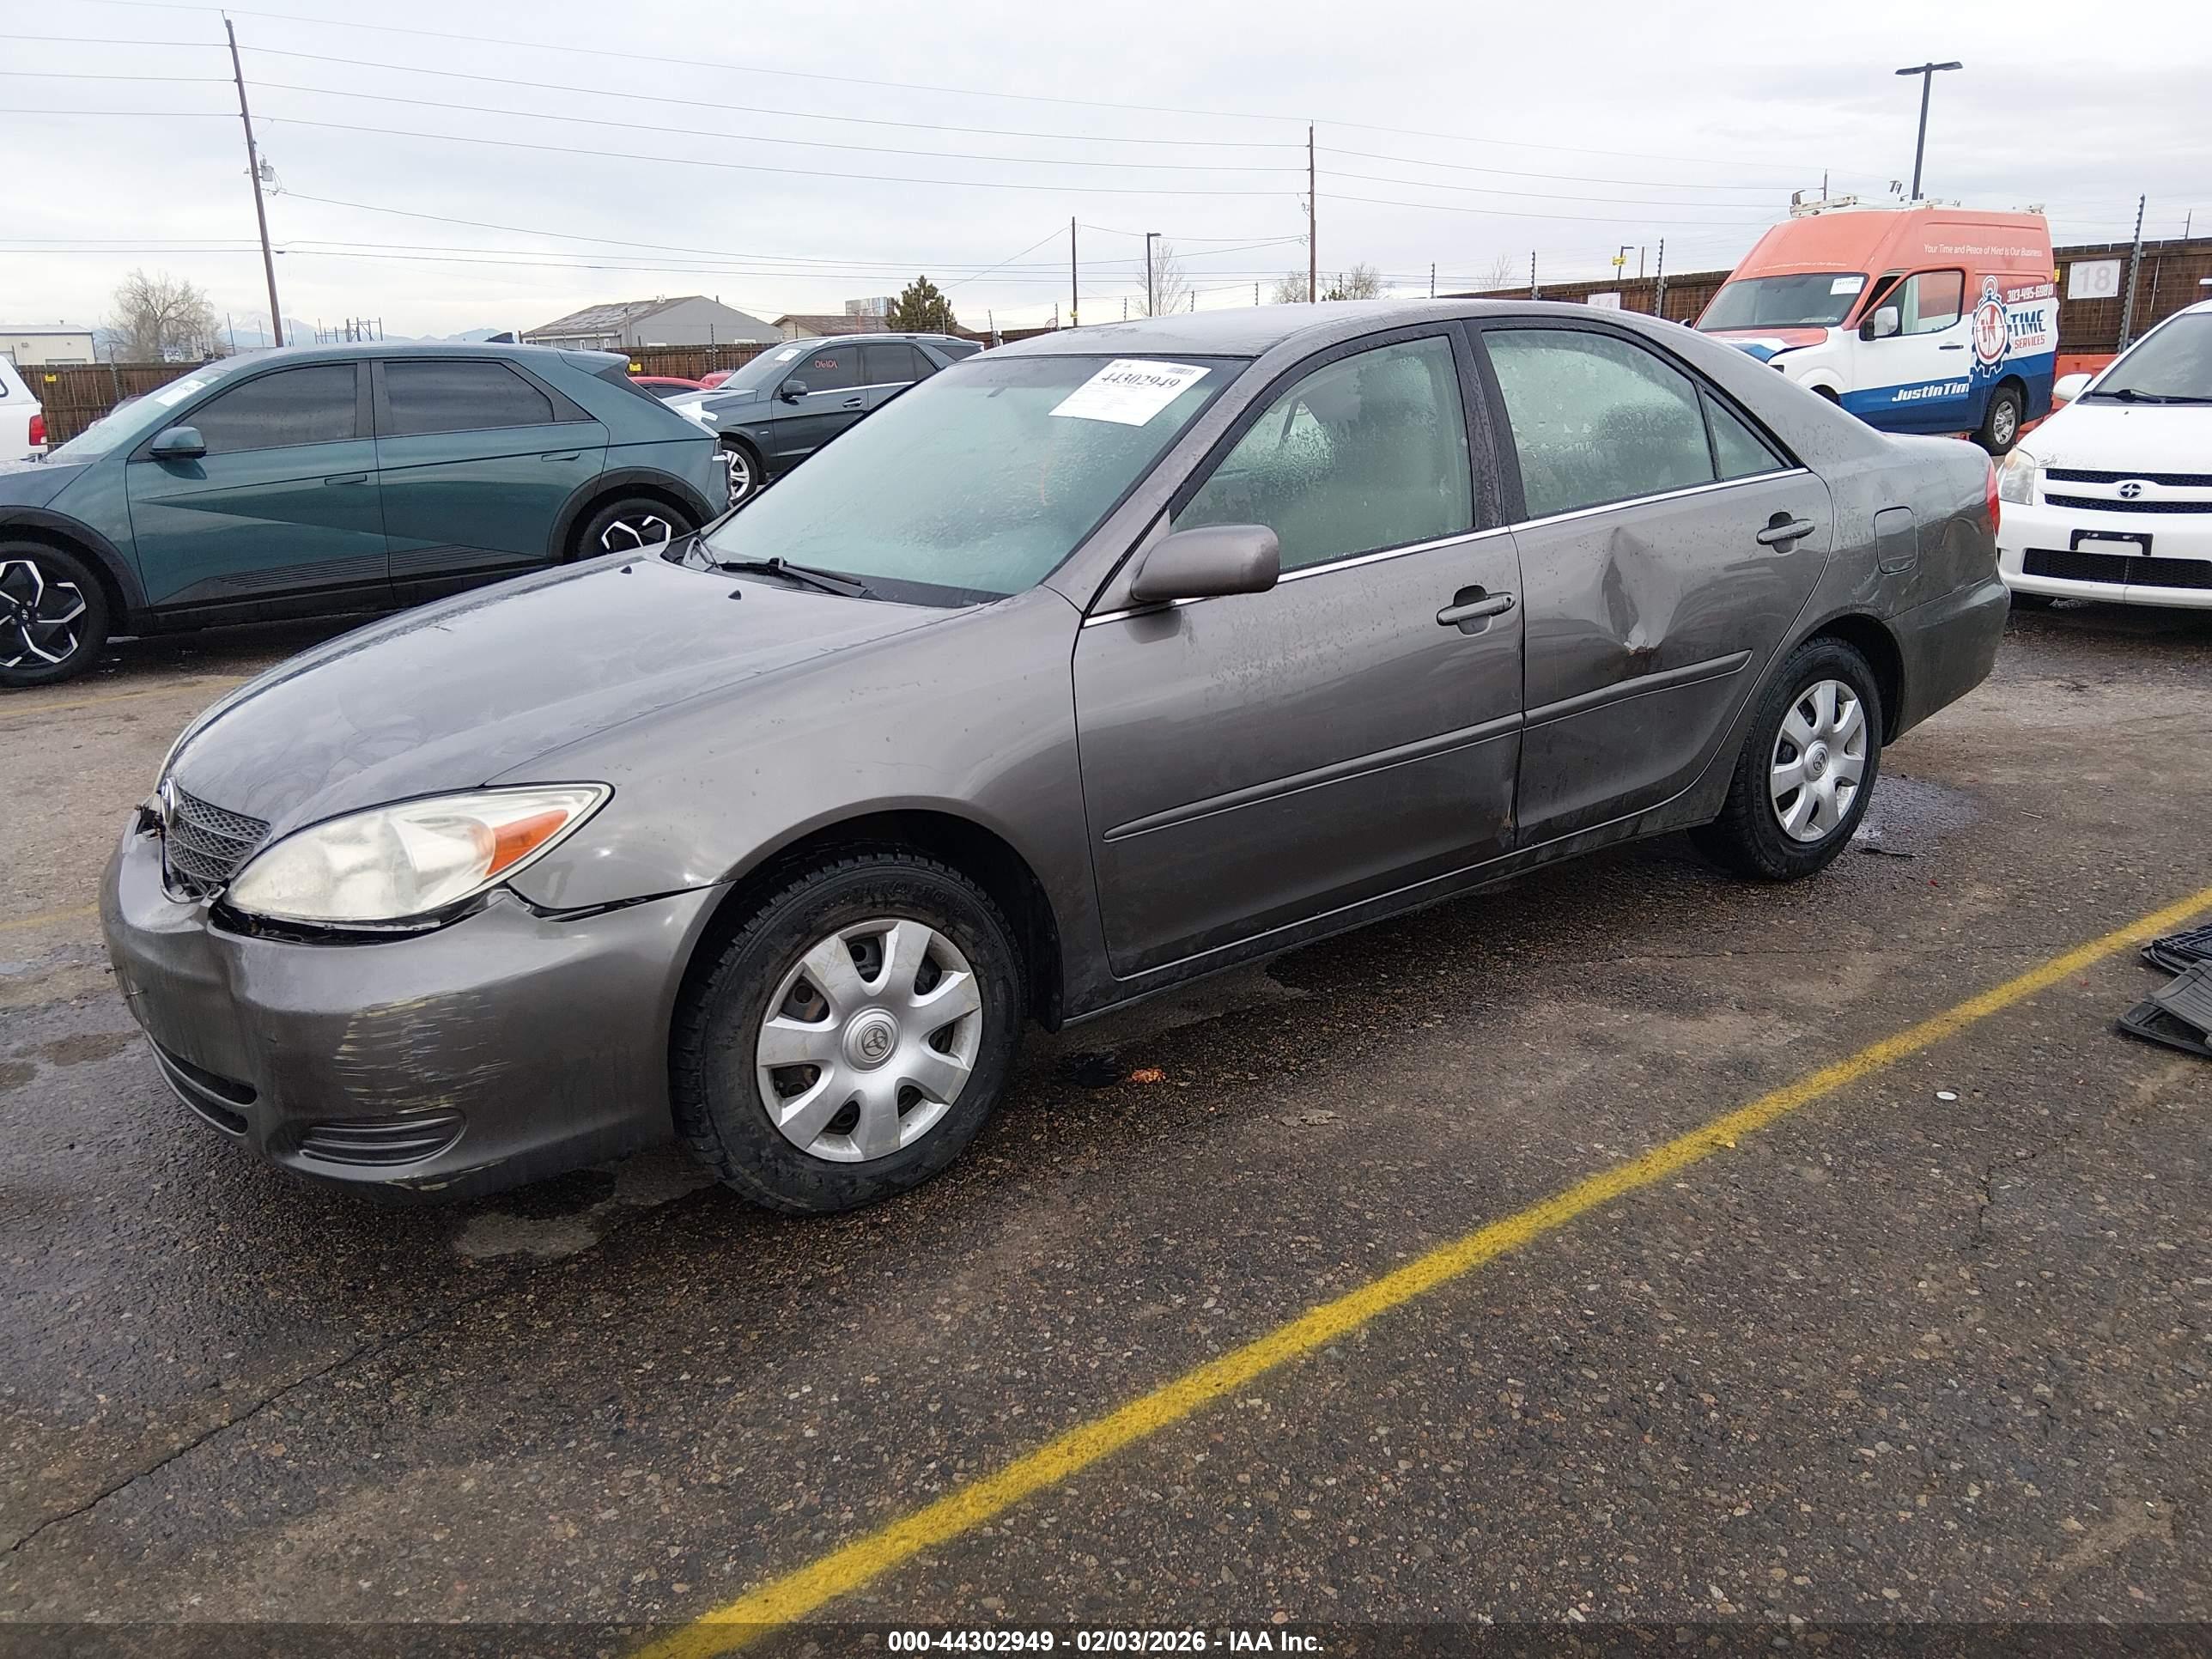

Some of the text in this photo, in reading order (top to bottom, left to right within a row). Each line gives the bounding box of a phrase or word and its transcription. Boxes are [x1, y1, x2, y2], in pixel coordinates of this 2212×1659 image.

[1923, 243, 1937, 254] Your
[1939, 243, 1954, 254] Time
[1954, 245, 1966, 254] and
[1966, 246, 1982, 255] Peace
[1984, 246, 1990, 255] of
[1990, 246, 2004, 255] Mind
[2010, 247, 2021, 256] Our
[2021, 247, 2043, 257] Business
[2080, 266, 2111, 292] 18
[2007, 308, 2046, 337] TIME
[2014, 334, 2046, 349] SERVICES
[1101, 372, 1181, 388] 44302949
